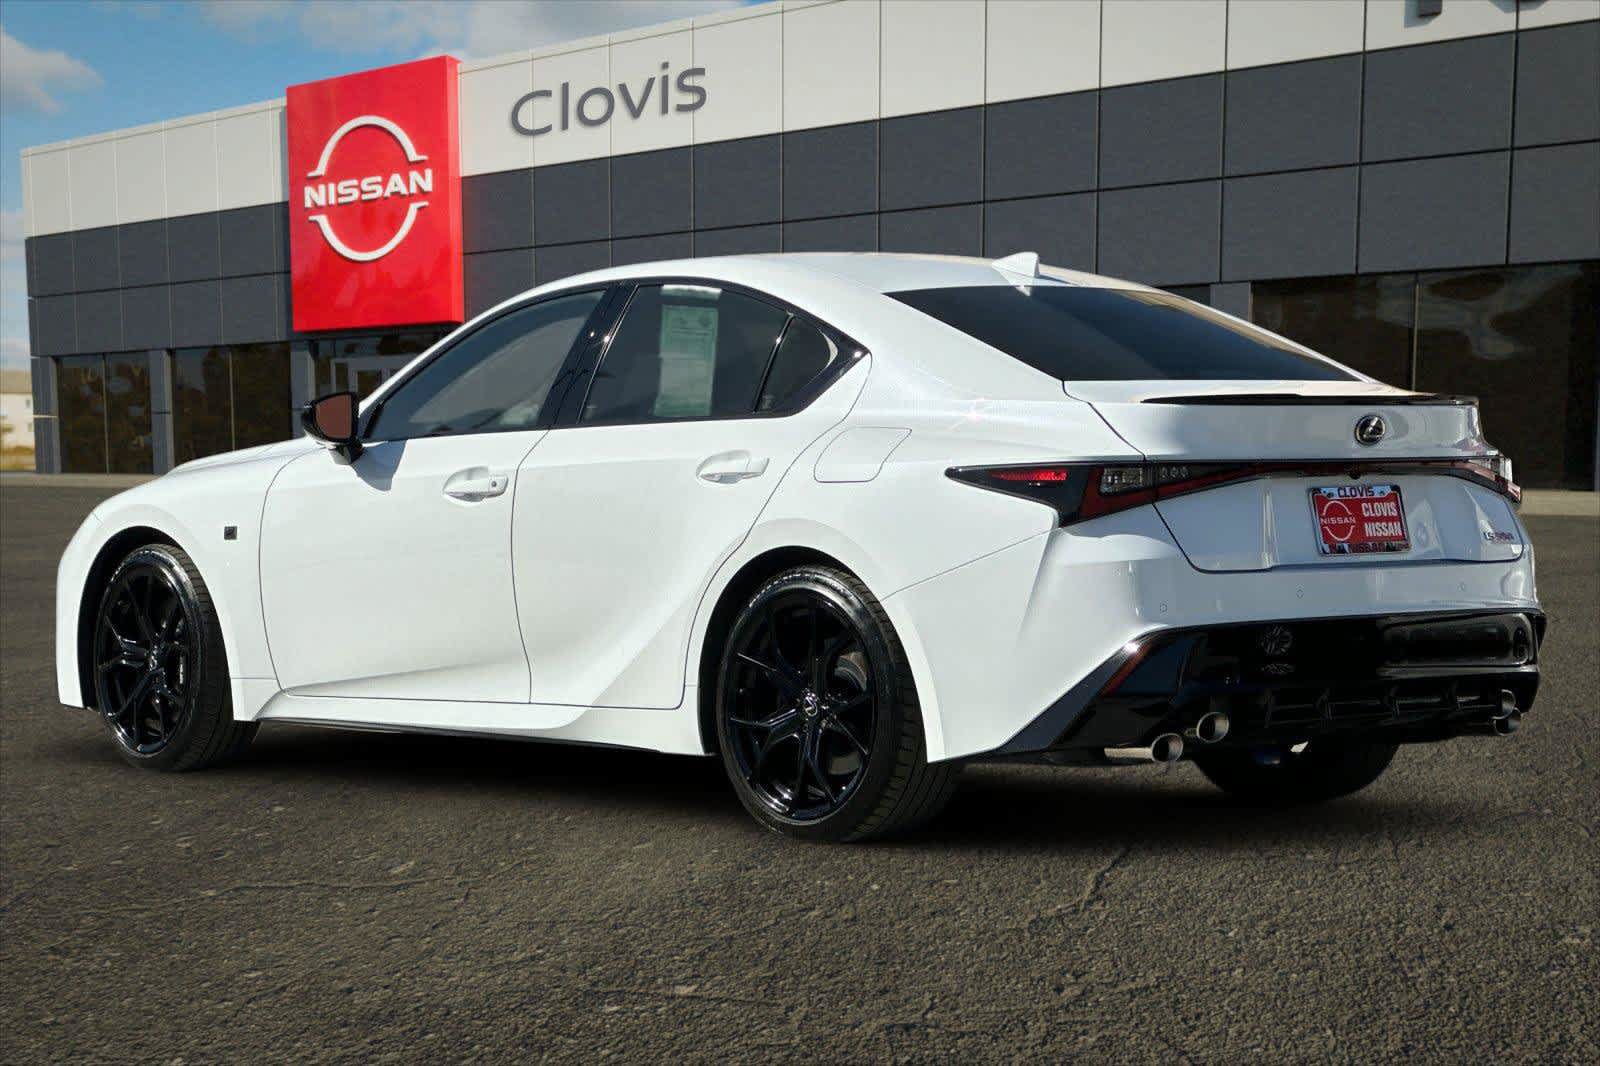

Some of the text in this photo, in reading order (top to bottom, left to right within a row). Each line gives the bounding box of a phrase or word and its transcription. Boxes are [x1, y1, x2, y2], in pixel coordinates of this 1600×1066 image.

[511, 62, 708, 136] Clovis
[304, 168, 434, 208] NISSAN
[1338, 487, 1374, 498] CLOVIS
[1361, 502, 1398, 516] CLOVIS
[1320, 517, 1356, 525] NISSAN
[1364, 522, 1402, 537] NISSAN
